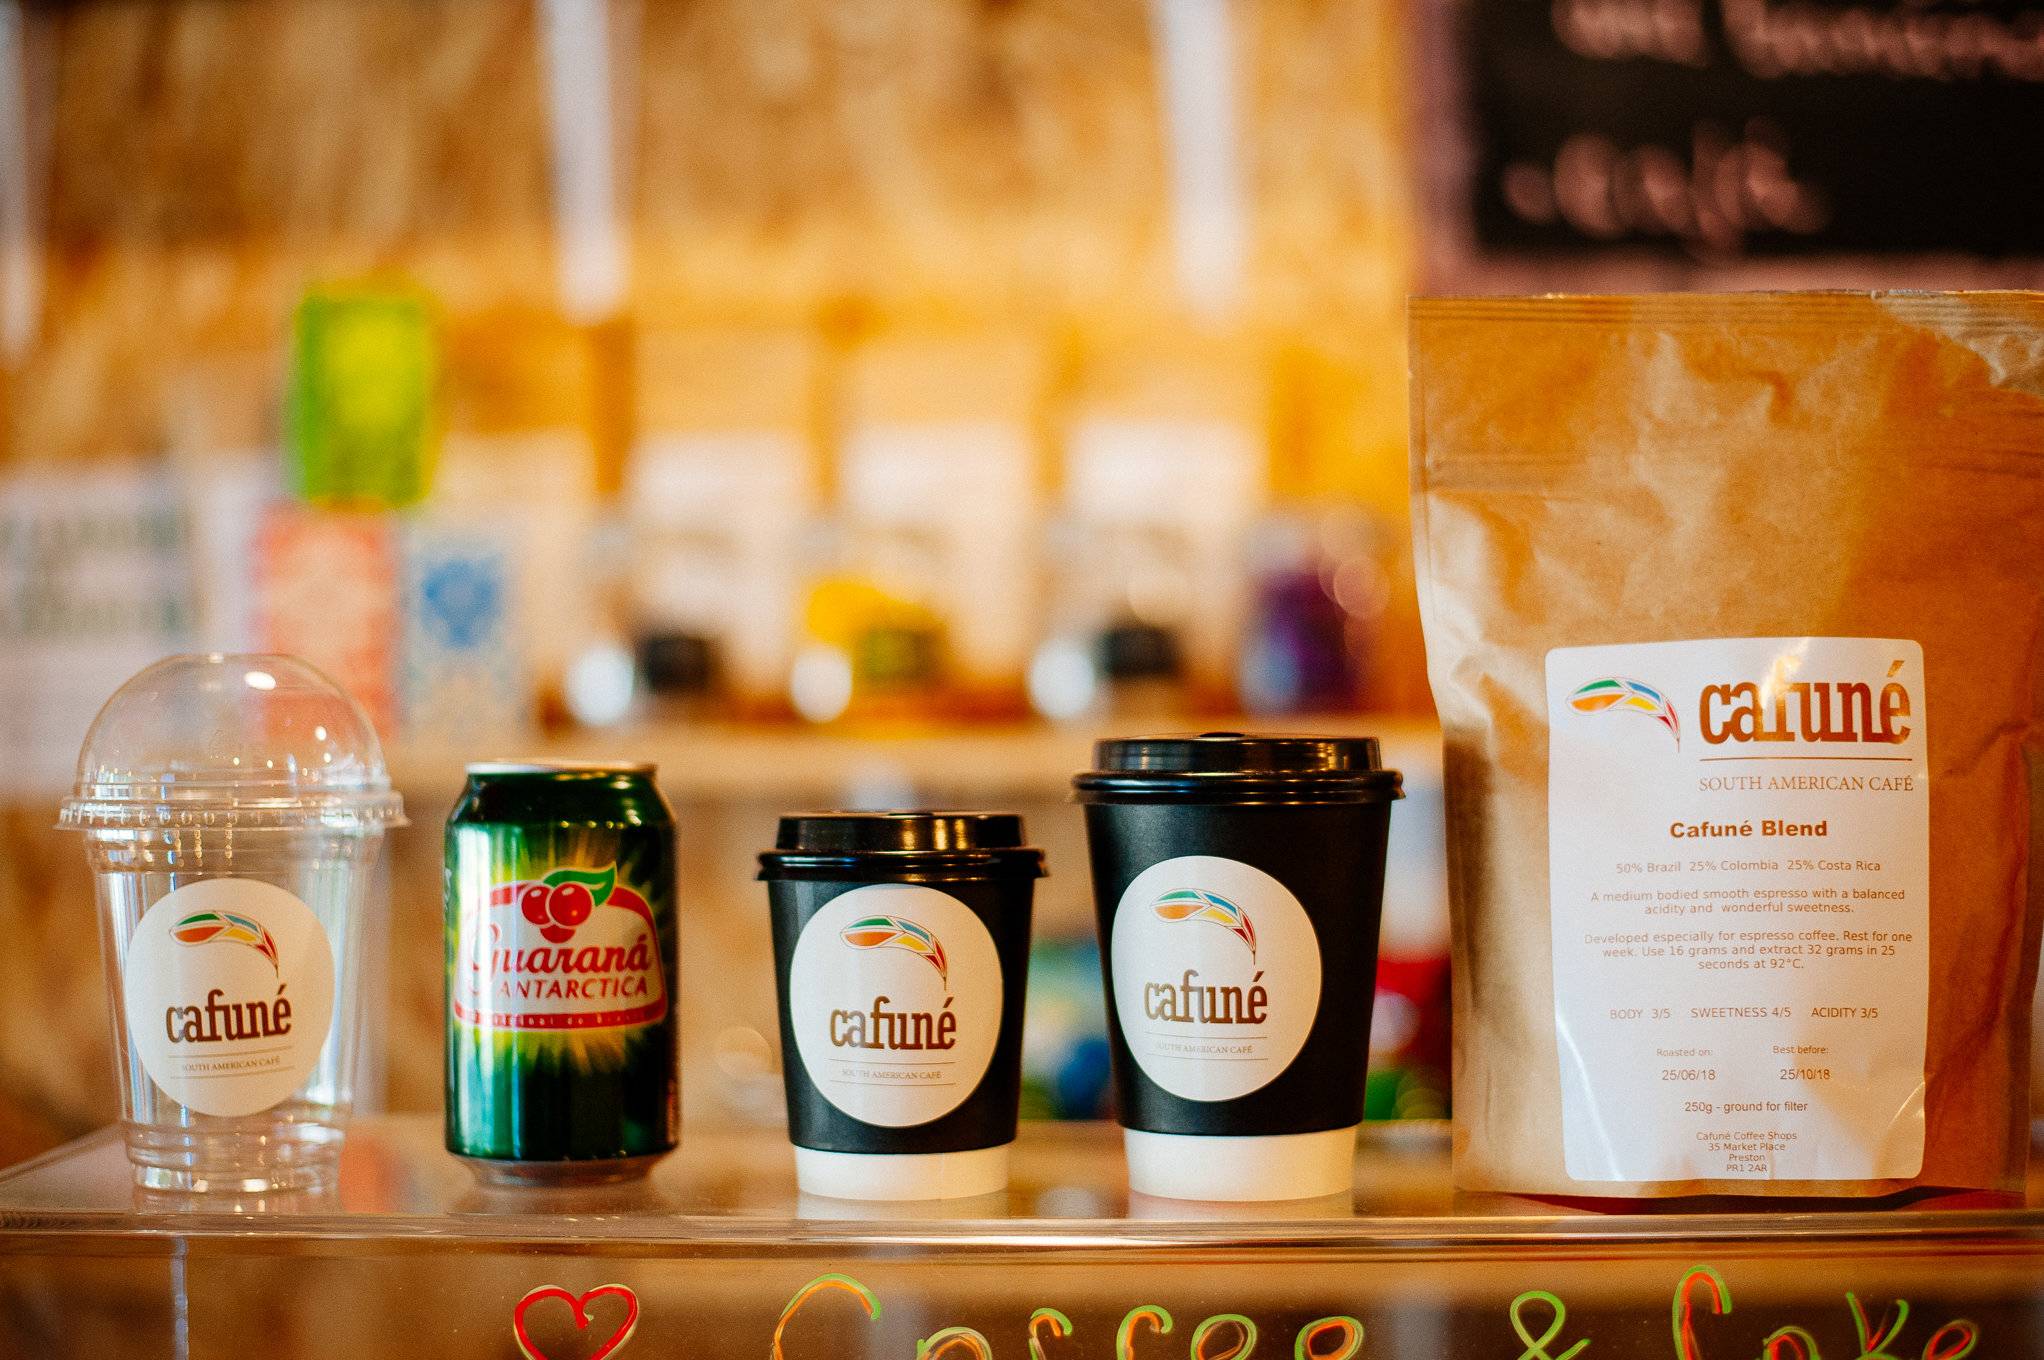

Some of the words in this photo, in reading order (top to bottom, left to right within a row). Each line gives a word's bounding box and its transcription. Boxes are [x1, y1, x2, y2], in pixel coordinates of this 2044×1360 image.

[1699, 656, 1912, 745] cafuné
[1699, 776, 1762, 791] SOUTH
[1768, 776, 1864, 791] AMERICAN
[1868, 775, 1914, 791] CAFÉ
[1669, 820, 1753, 838] Cafuné
[1761, 820, 1828, 837] Blend
[1616, 863, 1643, 874] 50%
[1647, 861, 1681, 873] Brazil
[1689, 861, 1717, 872] 25%
[1720, 859, 1779, 871] Colombia
[1787, 860, 1814, 871] 25%
[1817, 860, 1852, 871] Costa
[1856, 860, 1881, 871] Rica
[1591, 892, 1600, 902] A
[1603, 890, 1653, 901] medium
[1657, 890, 1699, 900] bodied
[1703, 889, 1749, 899] smooth
[1753, 890, 1808, 902] espresso
[1812, 888, 1837, 899] with
[1841, 891, 1849, 899] a
[1853, 888, 1905, 900] balanced
[1645, 904, 1685, 916] acidity
[1690, 903, 1713, 913] and
[1721, 902, 1783, 913] wonderful
[1787, 903, 1854, 913] sweetness.
[1585, 932, 1649, 945] Developed
[1653, 930, 1714, 944] especially
[1718, 930, 1735, 942] for
[1739, 931, 1794, 943] espresso
[1799, 929, 1840, 941] coffee.
[1843, 930, 1869, 941] Rest
[1872, 930, 1888, 942] for
[1891, 934, 1912, 942] one
[1602, 948, 1638, 958] week.
[1642, 946, 1665, 957] Use
[1670, 946, 1684, 956] 16
[1688, 947, 1728, 958] grams
[1732, 944, 1755, 955] and
[1760, 944, 1803, 955] extract
[1807, 944, 1822, 955] 32
[1826, 946, 1863, 957] grams
[1867, 945, 1878, 955] in
[1881, 945, 1896, 955] 25
[1698, 958, 1749, 970] seconds
[1754, 959, 1766, 969] at
[1770, 958, 1804, 969] 92°C.
[498, 977, 648, 999] ANTARCTICA
[1144, 969, 1268, 1025] cafuné
[166, 983, 292, 1044] cafuné
[1610, 1009, 1643, 1020] BODY
[1651, 1008, 1671, 1020] 3/5
[1690, 1007, 1768, 1018] SWEETNESS
[1772, 1007, 1791, 1018] 4/5
[1811, 1007, 1857, 1018] ACIDITY
[1860, 1008, 1879, 1019] 3/5
[830, 996, 957, 1051] cafuné
[1158, 1041, 1181, 1052] OUTH
[1183, 1044, 1227, 1054] AMERICAN
[1229, 1045, 1253, 1054] CAFÉ
[1656, 1048, 1695, 1057] Roasted
[1698, 1049, 1713, 1057] on:
[1773, 1045, 1795, 1054] Best
[1797, 1045, 1829, 1054] before:
[212, 1060, 258, 1071] AMERICAN
[259, 1055, 281, 1067] CAFÉ
[872, 1071, 918, 1080] AMERICAN
[919, 1070, 942, 1080] CAFÉ
[1661, 1069, 1717, 1081] 25/06/18
[1780, 1069, 1831, 1080] 25/10/18
[1685, 1102, 1713, 1114] 250g
[1723, 1101, 1762, 1114] ground
[1766, 1101, 1781, 1112] for
[1784, 1101, 1808, 1112] filter
[1696, 1131, 1731, 1141] Cafuné
[1734, 1131, 1765, 1140] Coffee
[1767, 1130, 1798, 1141] Shops
[1708, 1142, 1721, 1152] 35
[1723, 1142, 1758, 1152] Market
[1760, 1141, 1786, 1151] Place
[1728, 1153, 1766, 1162] Preston
[1726, 1163, 1745, 1172] PR1
[1748, 1163, 1768, 1173] 2AR
